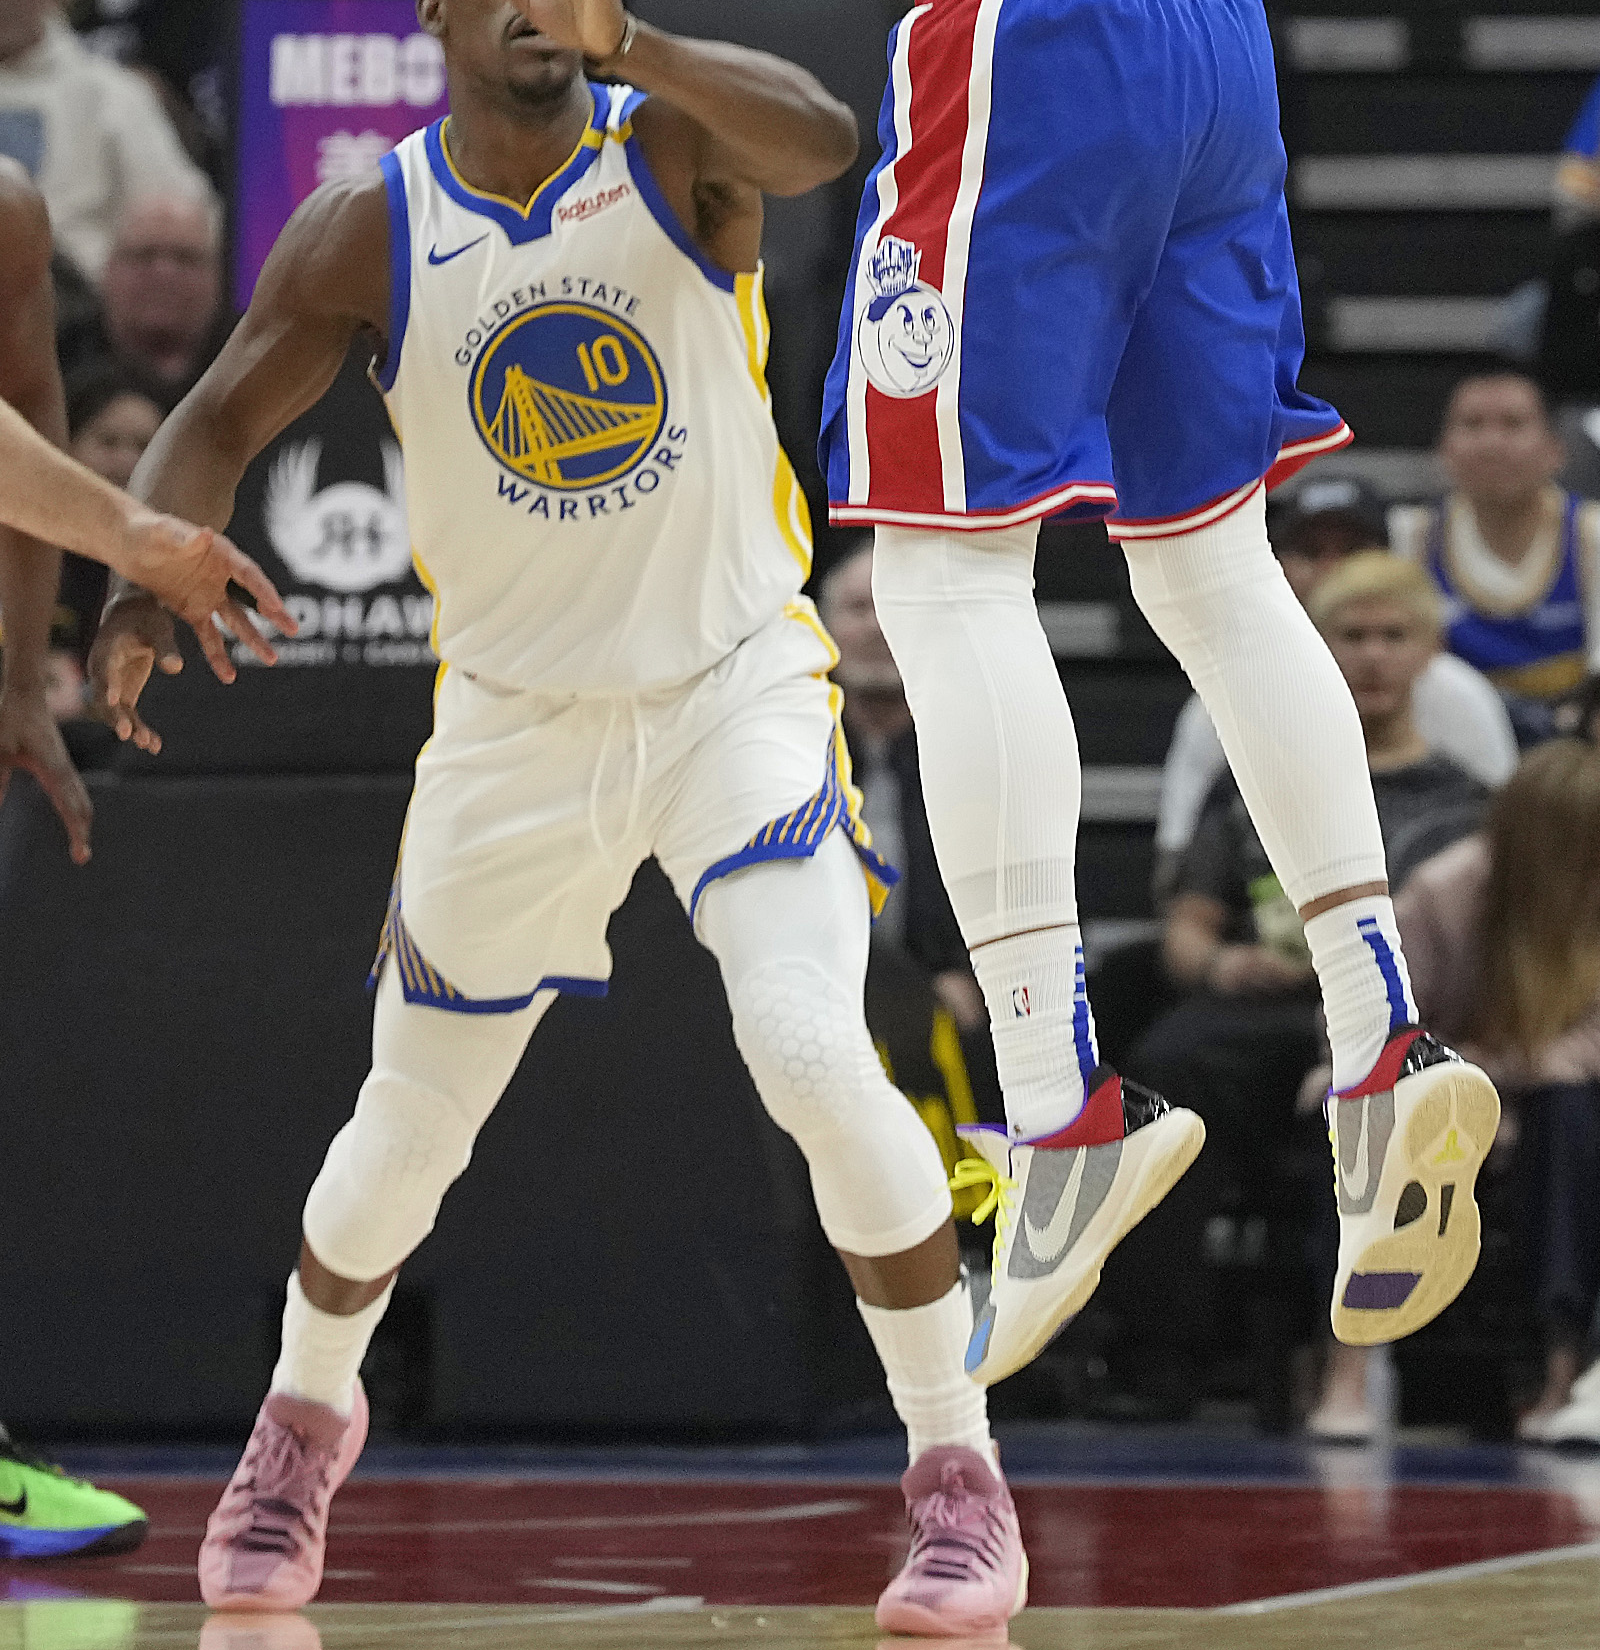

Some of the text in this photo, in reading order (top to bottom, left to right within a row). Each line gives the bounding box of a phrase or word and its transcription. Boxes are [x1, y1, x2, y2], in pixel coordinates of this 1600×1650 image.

[558, 183, 631, 225] Rakuten
[455, 276, 642, 376] GOLDEN STATE
[576, 334, 630, 393] 10
[498, 424, 688, 521] WARRIORS
